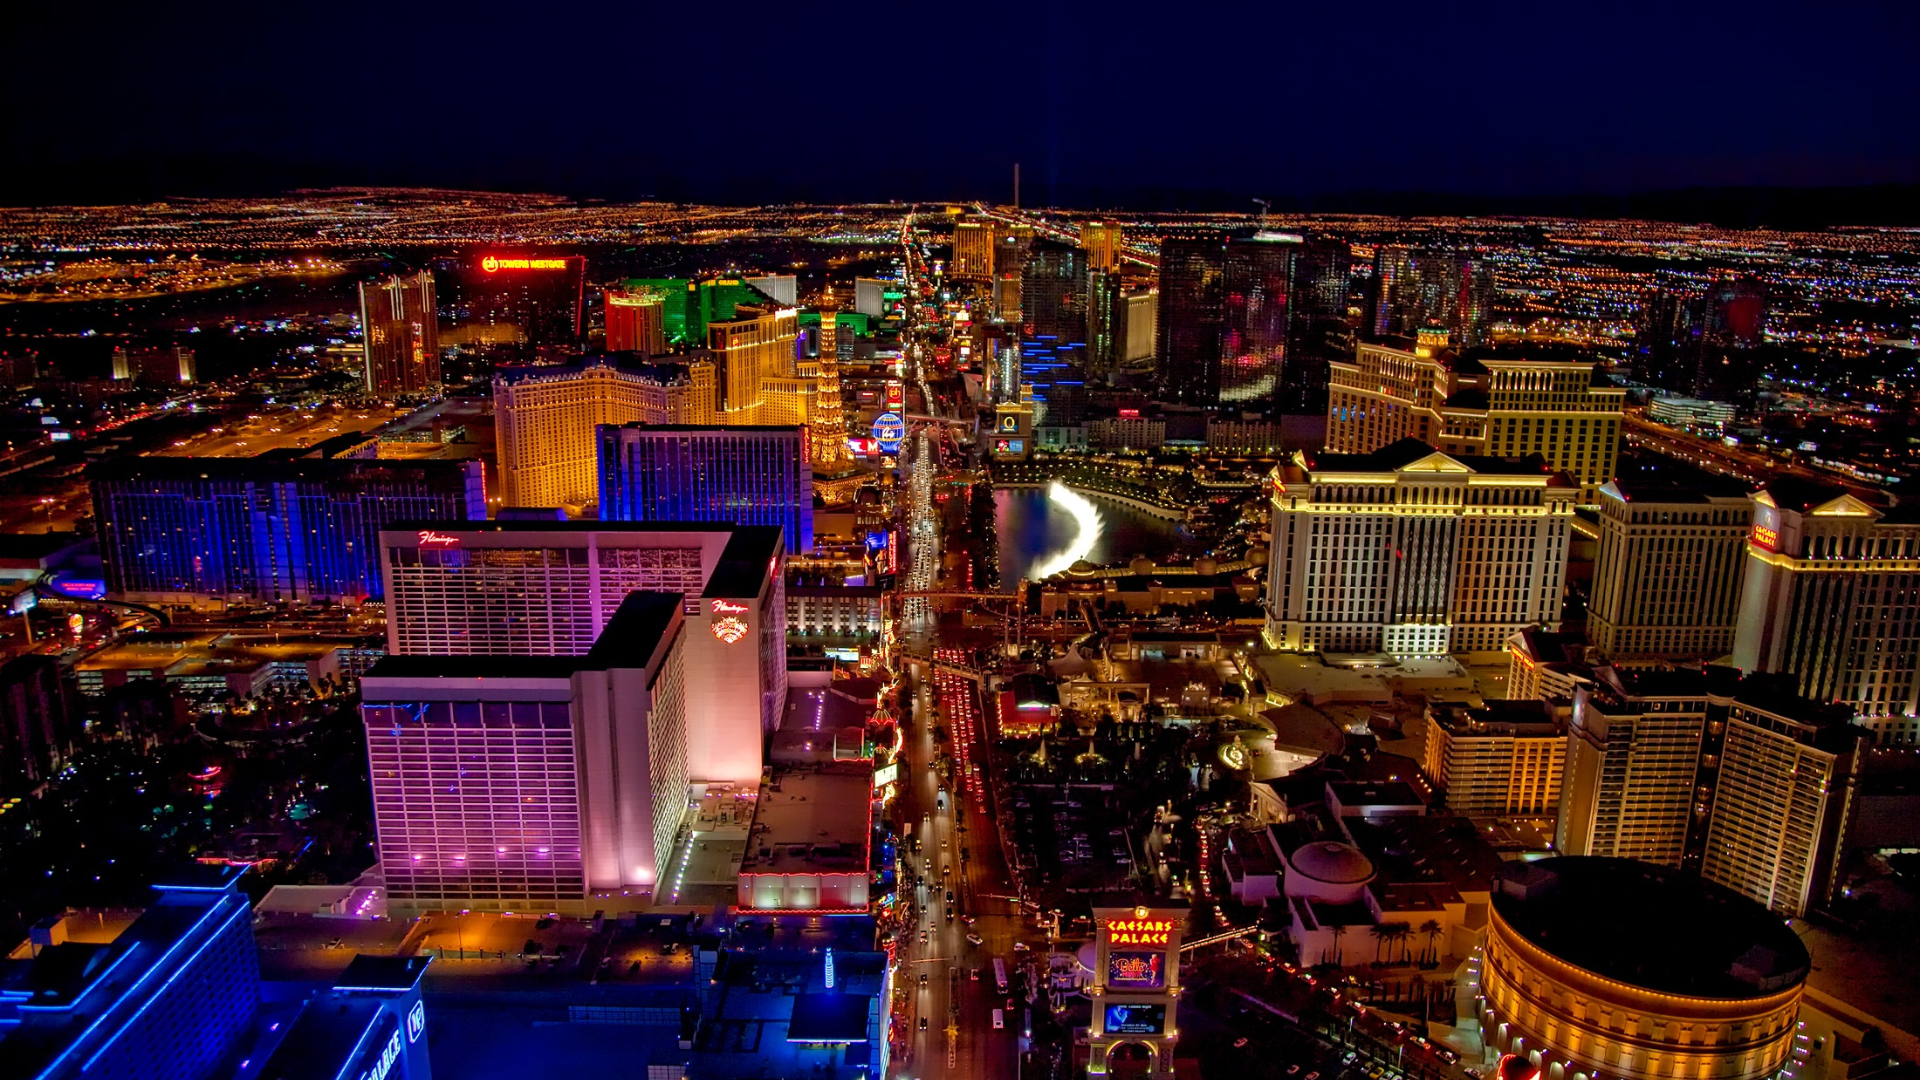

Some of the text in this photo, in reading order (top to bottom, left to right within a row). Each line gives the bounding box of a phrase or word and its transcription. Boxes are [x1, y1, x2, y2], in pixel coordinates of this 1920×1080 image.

[498, 259, 529, 269] TOWERS
[530, 259, 566, 269] WESTGATE
[419, 531, 459, 545] Flamingo
[1755, 525, 1776, 540] CAESARS
[1755, 532, 1774, 547] PALACE
[1108, 921, 1172, 932] CAESARS
[1111, 933, 1168, 943] PALACE
